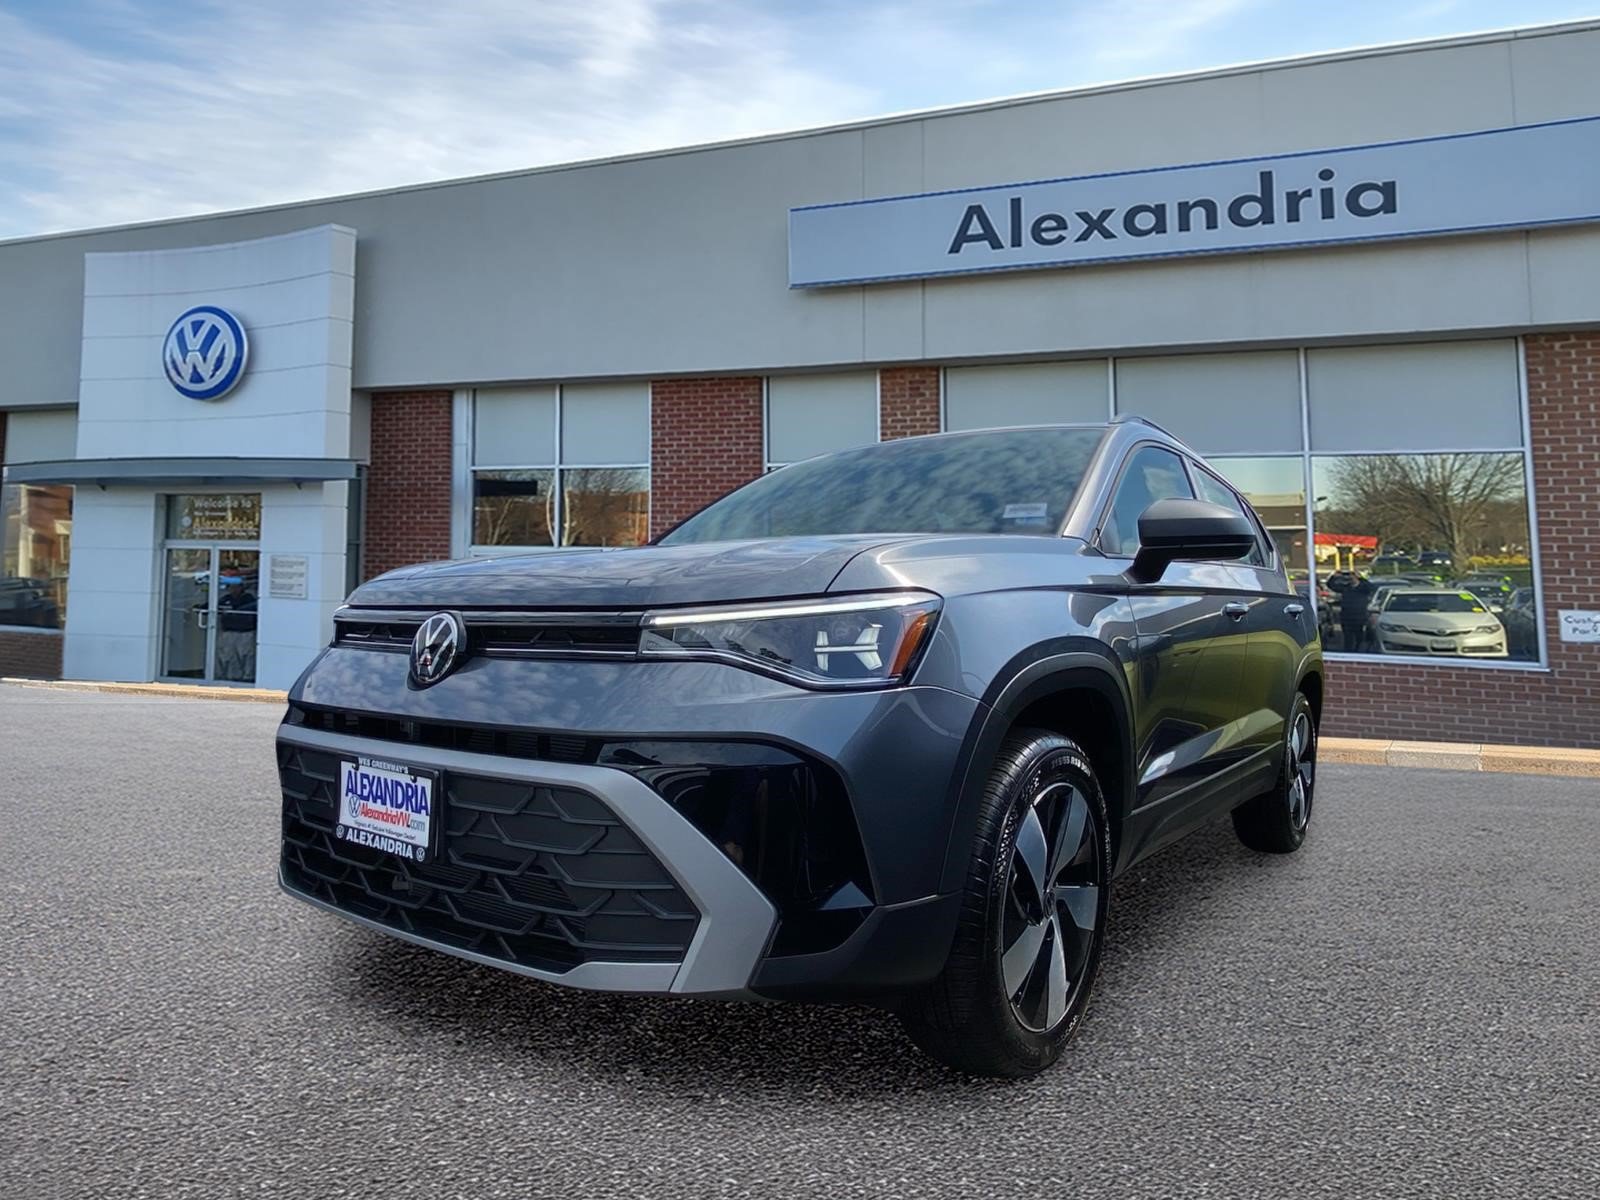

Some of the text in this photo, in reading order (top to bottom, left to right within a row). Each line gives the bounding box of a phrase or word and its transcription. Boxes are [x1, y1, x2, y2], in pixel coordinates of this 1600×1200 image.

[948, 167, 1398, 255] Alexandria
[164, 310, 240, 394] VW
[345, 769, 429, 816] ALEXANDRIA
[346, 828, 413, 859] ALEXANDRIA
